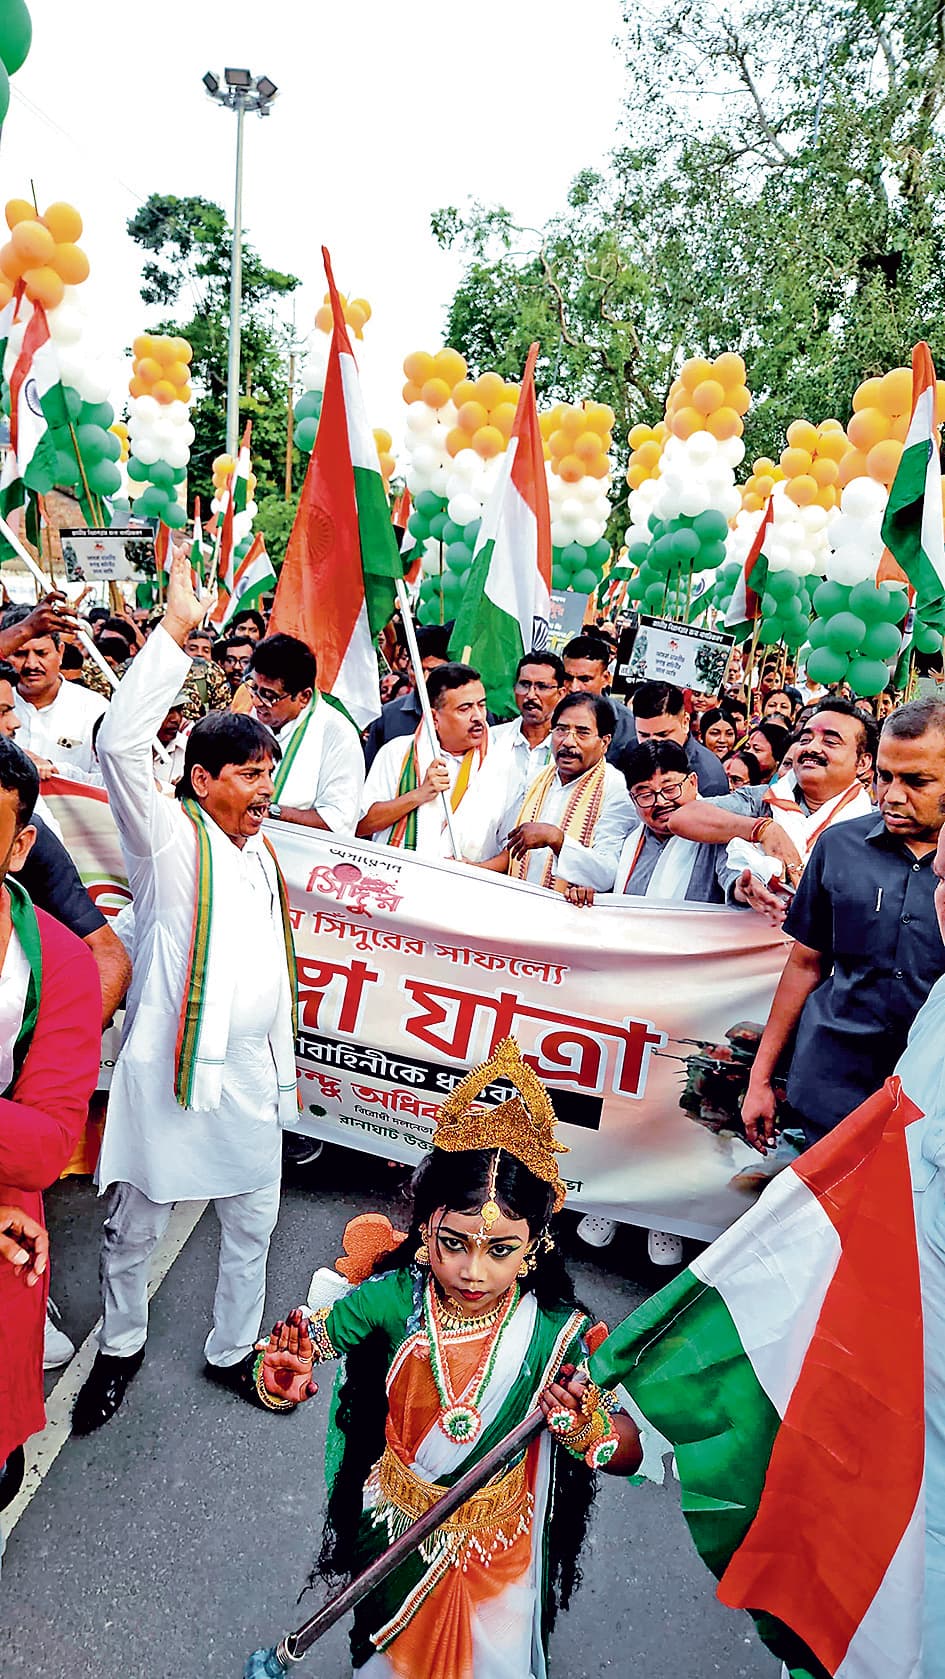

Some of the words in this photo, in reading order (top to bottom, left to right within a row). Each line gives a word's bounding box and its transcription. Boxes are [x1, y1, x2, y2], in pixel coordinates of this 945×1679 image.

[312, 909, 427, 954] সিঁদুরের
[433, 941, 570, 985] সাফল্যে
[404, 979, 662, 1097] যাত্রা
